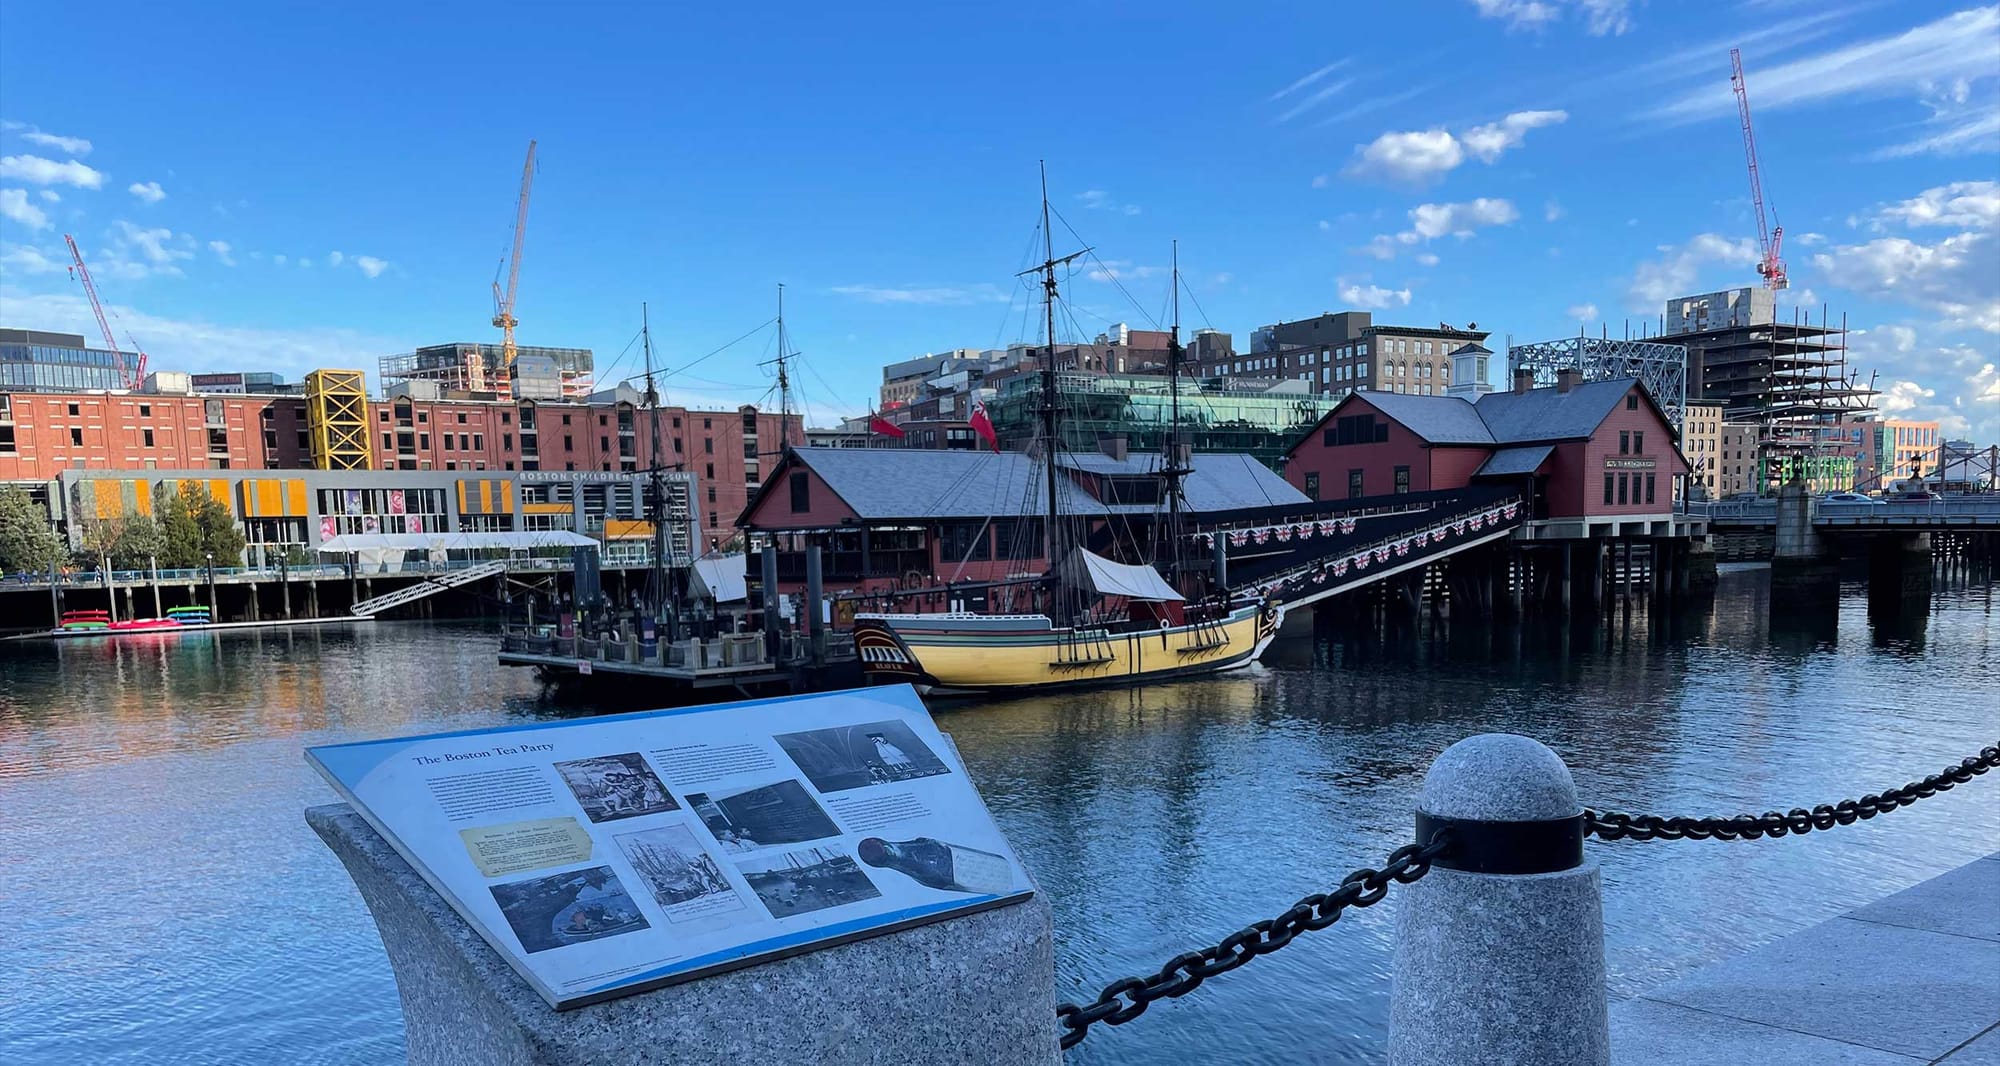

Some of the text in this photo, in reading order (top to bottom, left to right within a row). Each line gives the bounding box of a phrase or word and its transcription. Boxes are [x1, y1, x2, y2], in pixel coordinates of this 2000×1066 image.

[519, 473, 567, 481] BOSTON
[412, 743, 554, 766] The Boston Tea Party
